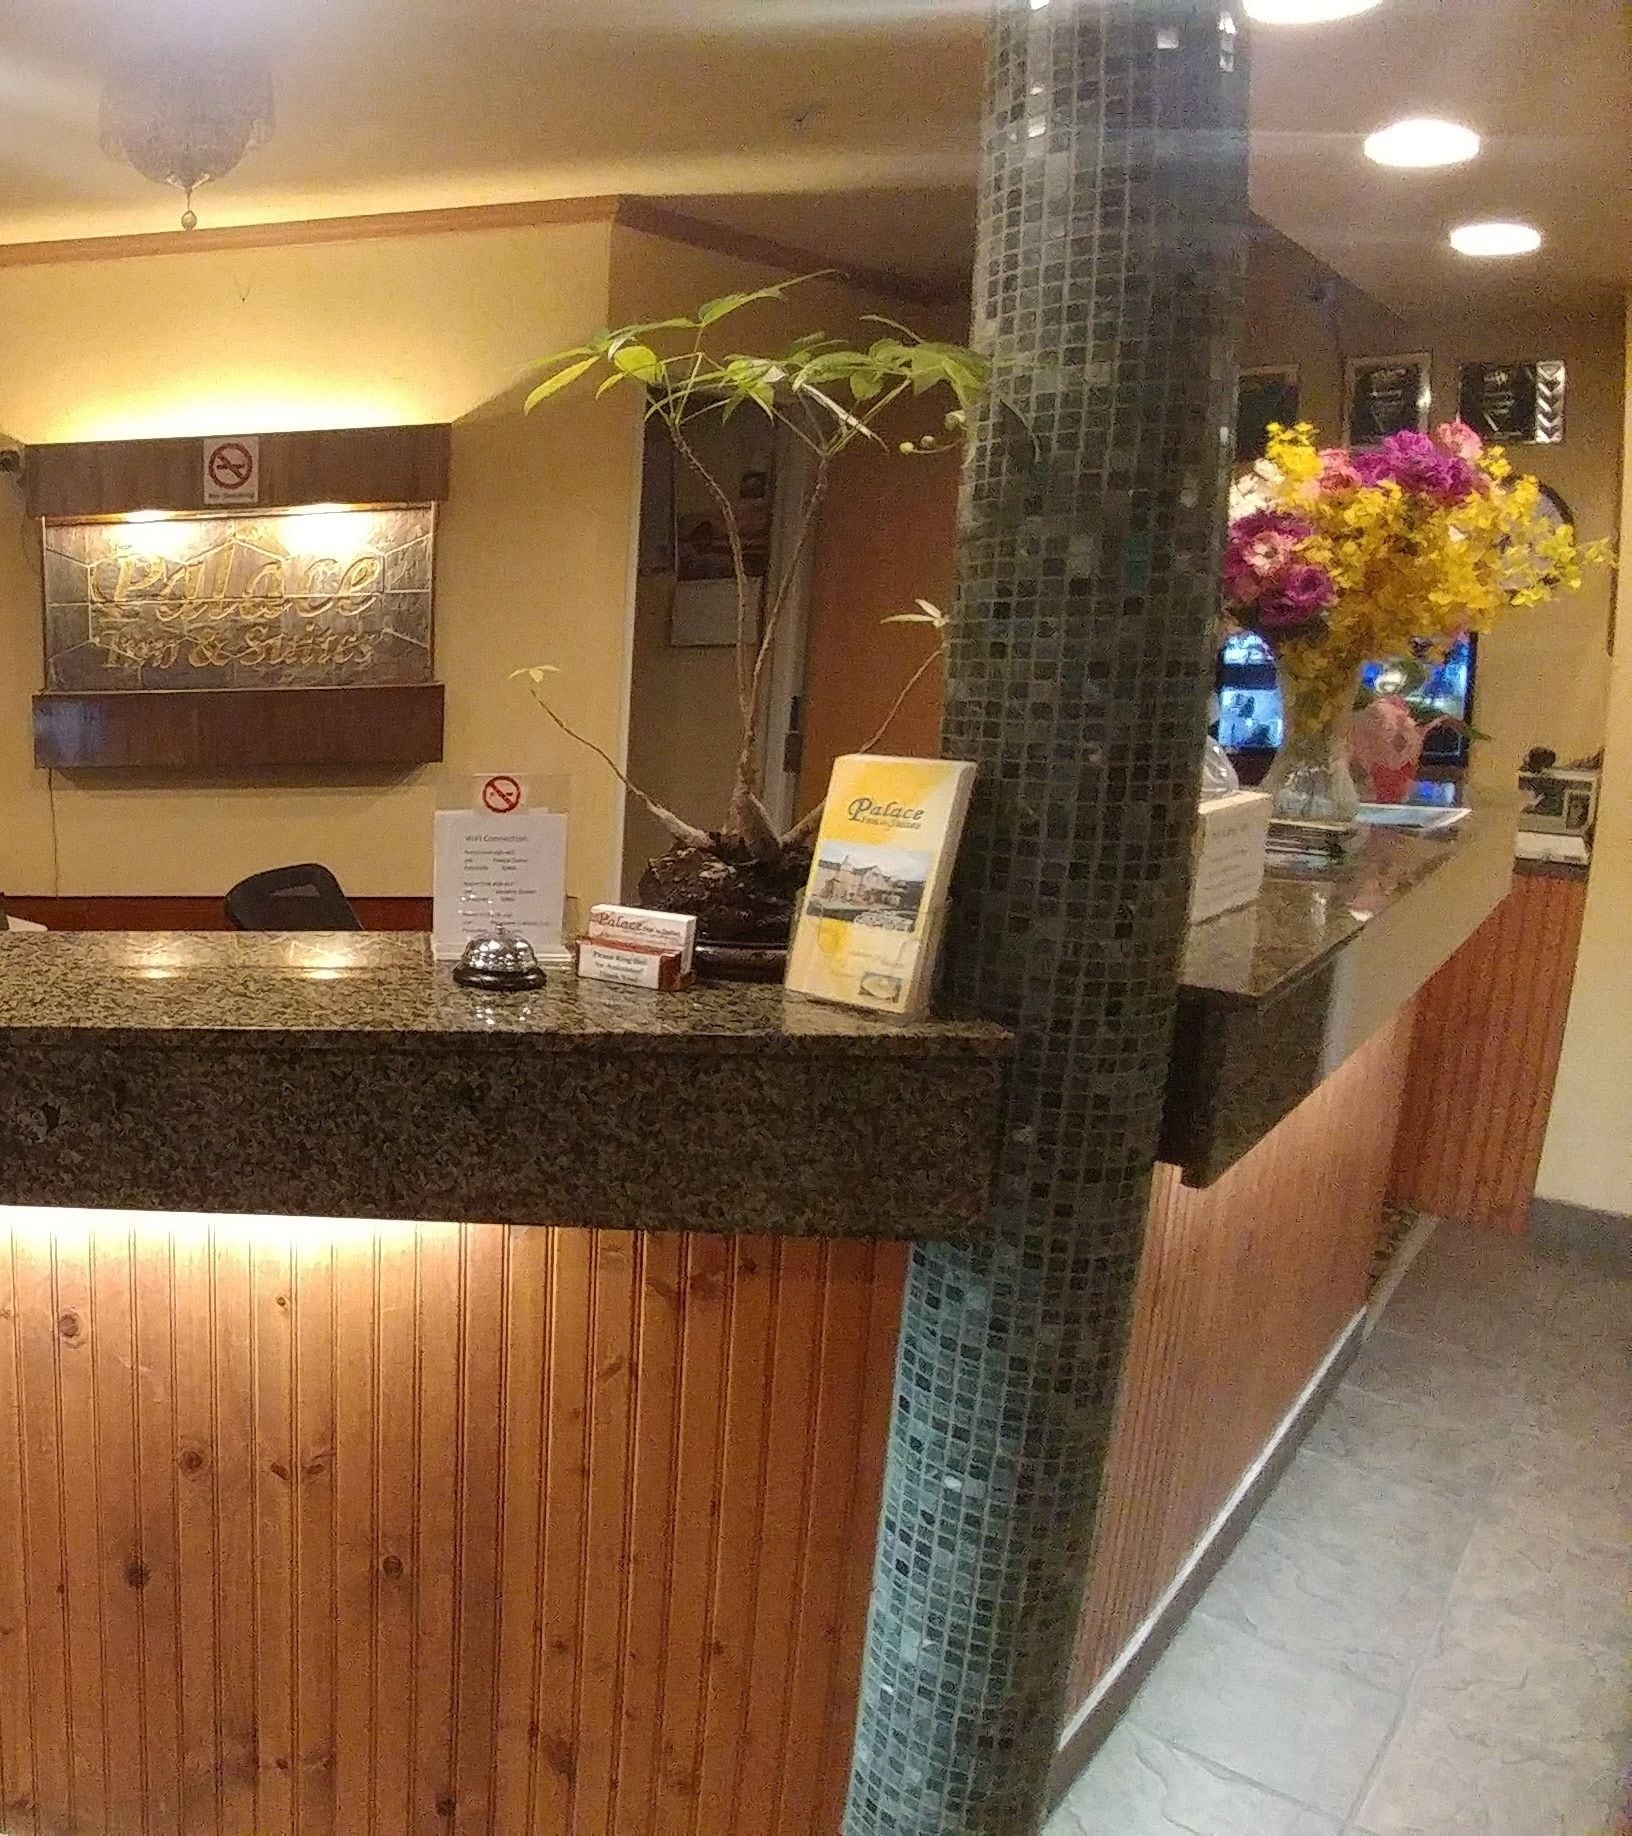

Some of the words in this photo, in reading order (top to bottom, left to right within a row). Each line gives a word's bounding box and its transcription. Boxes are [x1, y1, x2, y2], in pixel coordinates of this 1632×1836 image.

[89, 553, 383, 621] Palace
[848, 797, 925, 822] Palace
[597, 911, 643, 932] Palace
